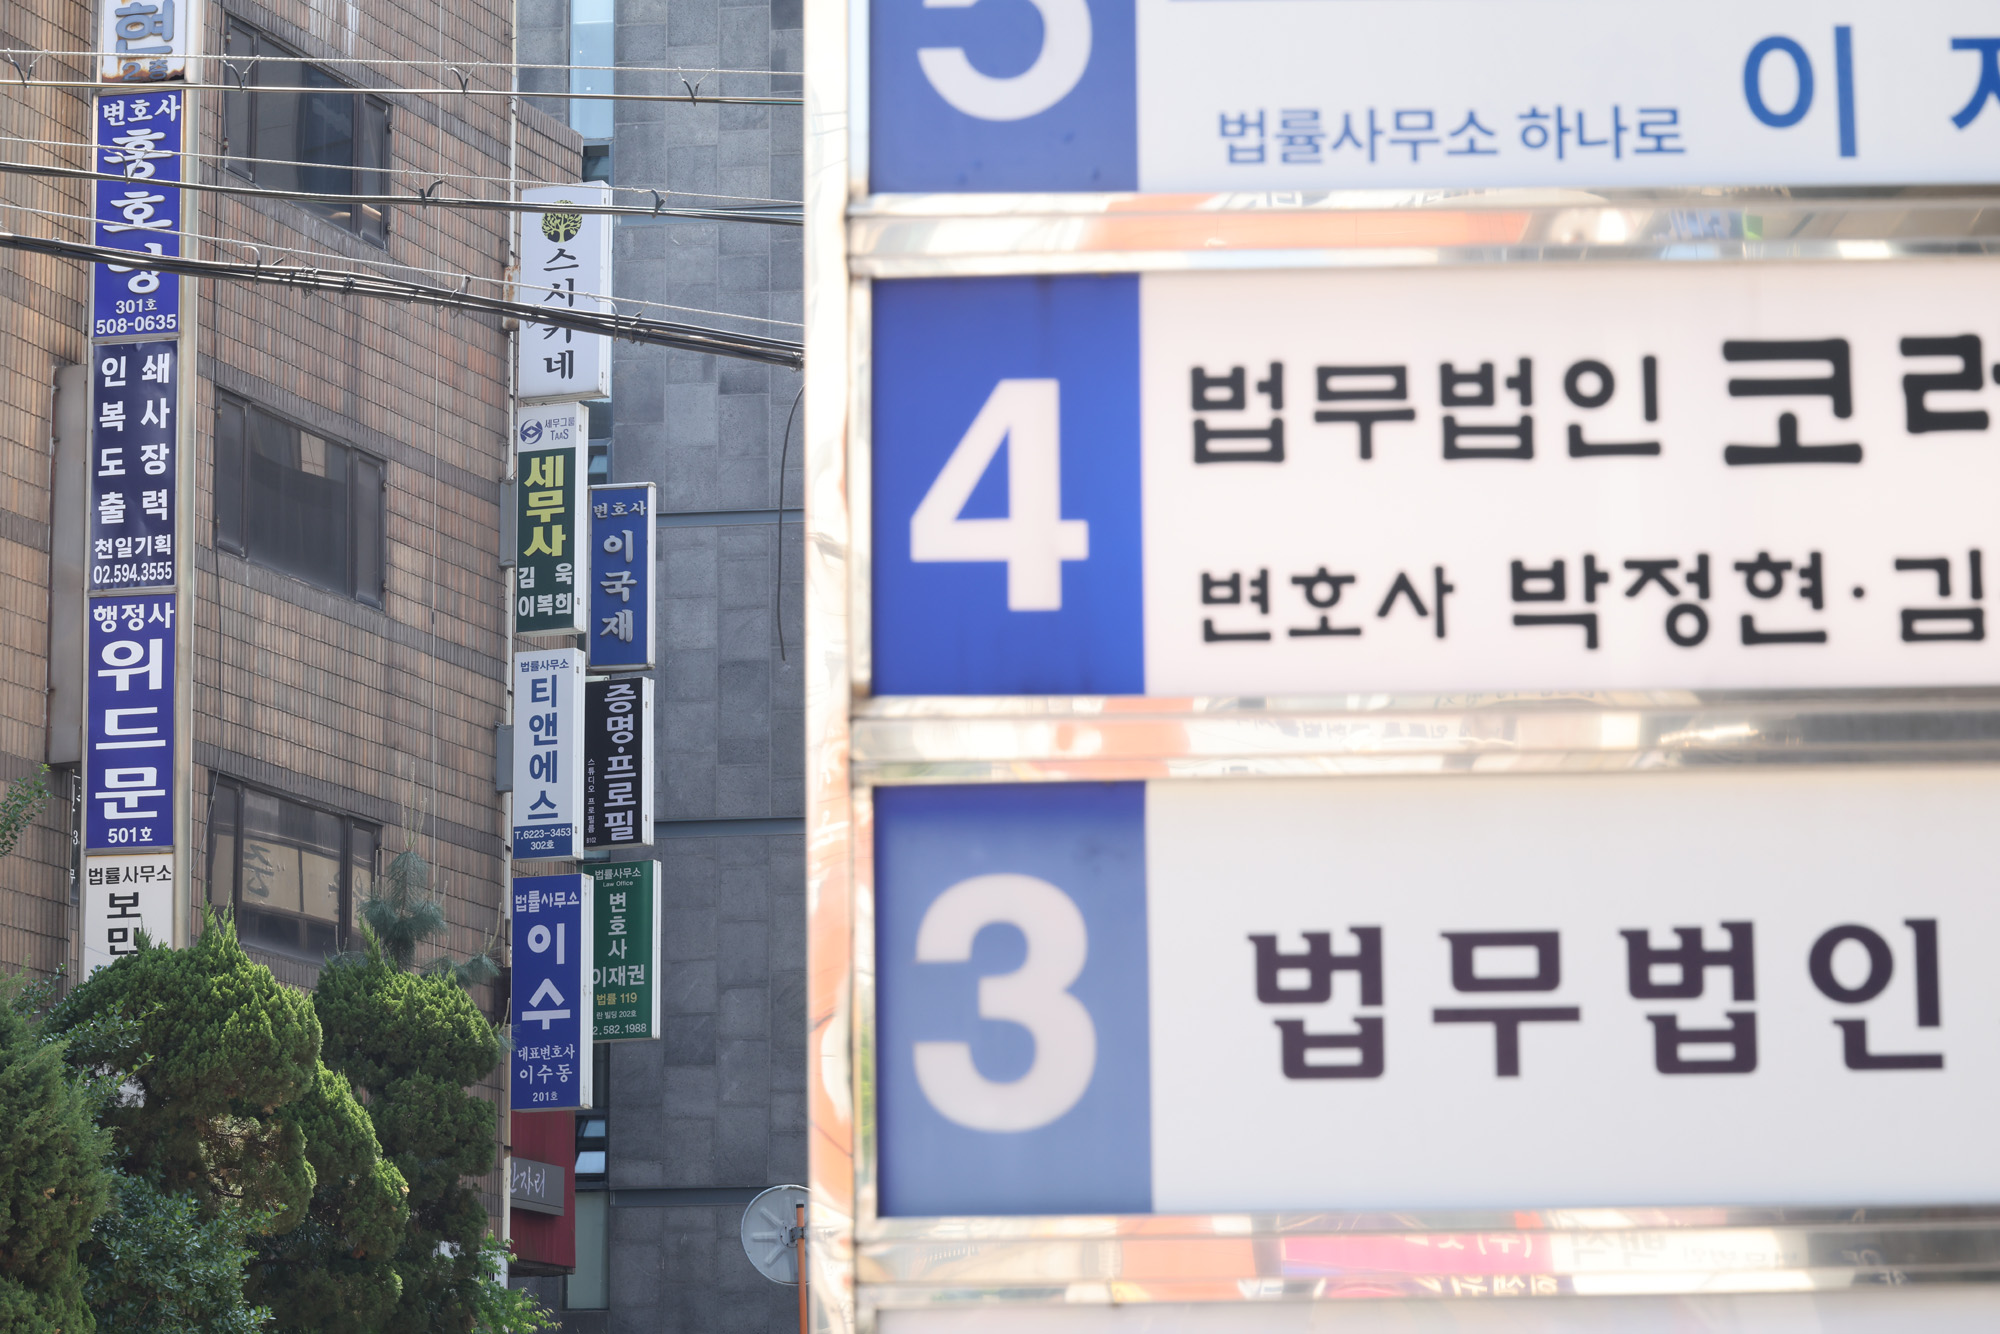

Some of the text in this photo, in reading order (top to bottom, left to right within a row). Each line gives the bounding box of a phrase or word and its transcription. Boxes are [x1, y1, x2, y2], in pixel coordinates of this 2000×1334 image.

[102, 94, 181, 126] 변호사
[1218, 104, 1686, 165] 법률사무소 하나로
[116, 298, 157, 314] 301호
[96, 314, 176, 334] 508-0635
[1191, 355, 1661, 464] 법무법인
[523, 454, 566, 557] 세무사
[910, 378, 1090, 612] 4
[593, 500, 647, 519] 변호사
[94, 534, 171, 559] 천일기획
[93, 561, 172, 584] 02.594.3555
[600, 529, 637, 643] 이국재
[518, 592, 572, 618] 이복희
[1201, 566, 1454, 643] 변호사
[93, 602, 175, 633] 행정사
[520, 658, 569, 672] 법률사무소
[95, 638, 166, 820] 위드문
[528, 674, 558, 820] 티앤에스
[107, 826, 153, 843] 501호
[515, 828, 572, 840] T.6223-3453
[530, 839, 555, 850] 302호
[88, 864, 172, 886] 법률사무소
[594, 867, 641, 881] 법률사무소
[515, 890, 579, 913] 법률사무소
[608, 892, 627, 960] 변호사
[521, 922, 571, 1030] 이수
[596, 992, 638, 1006] 법률 119
[913, 873, 1097, 1133] 3
[1246, 917, 1944, 1081] 법무법인
[619, 1009, 637, 1018] 202호
[517, 1043, 575, 1062] 대표변호사
[519, 1063, 573, 1085] 이수동
[532, 1091, 558, 1102] 201호
